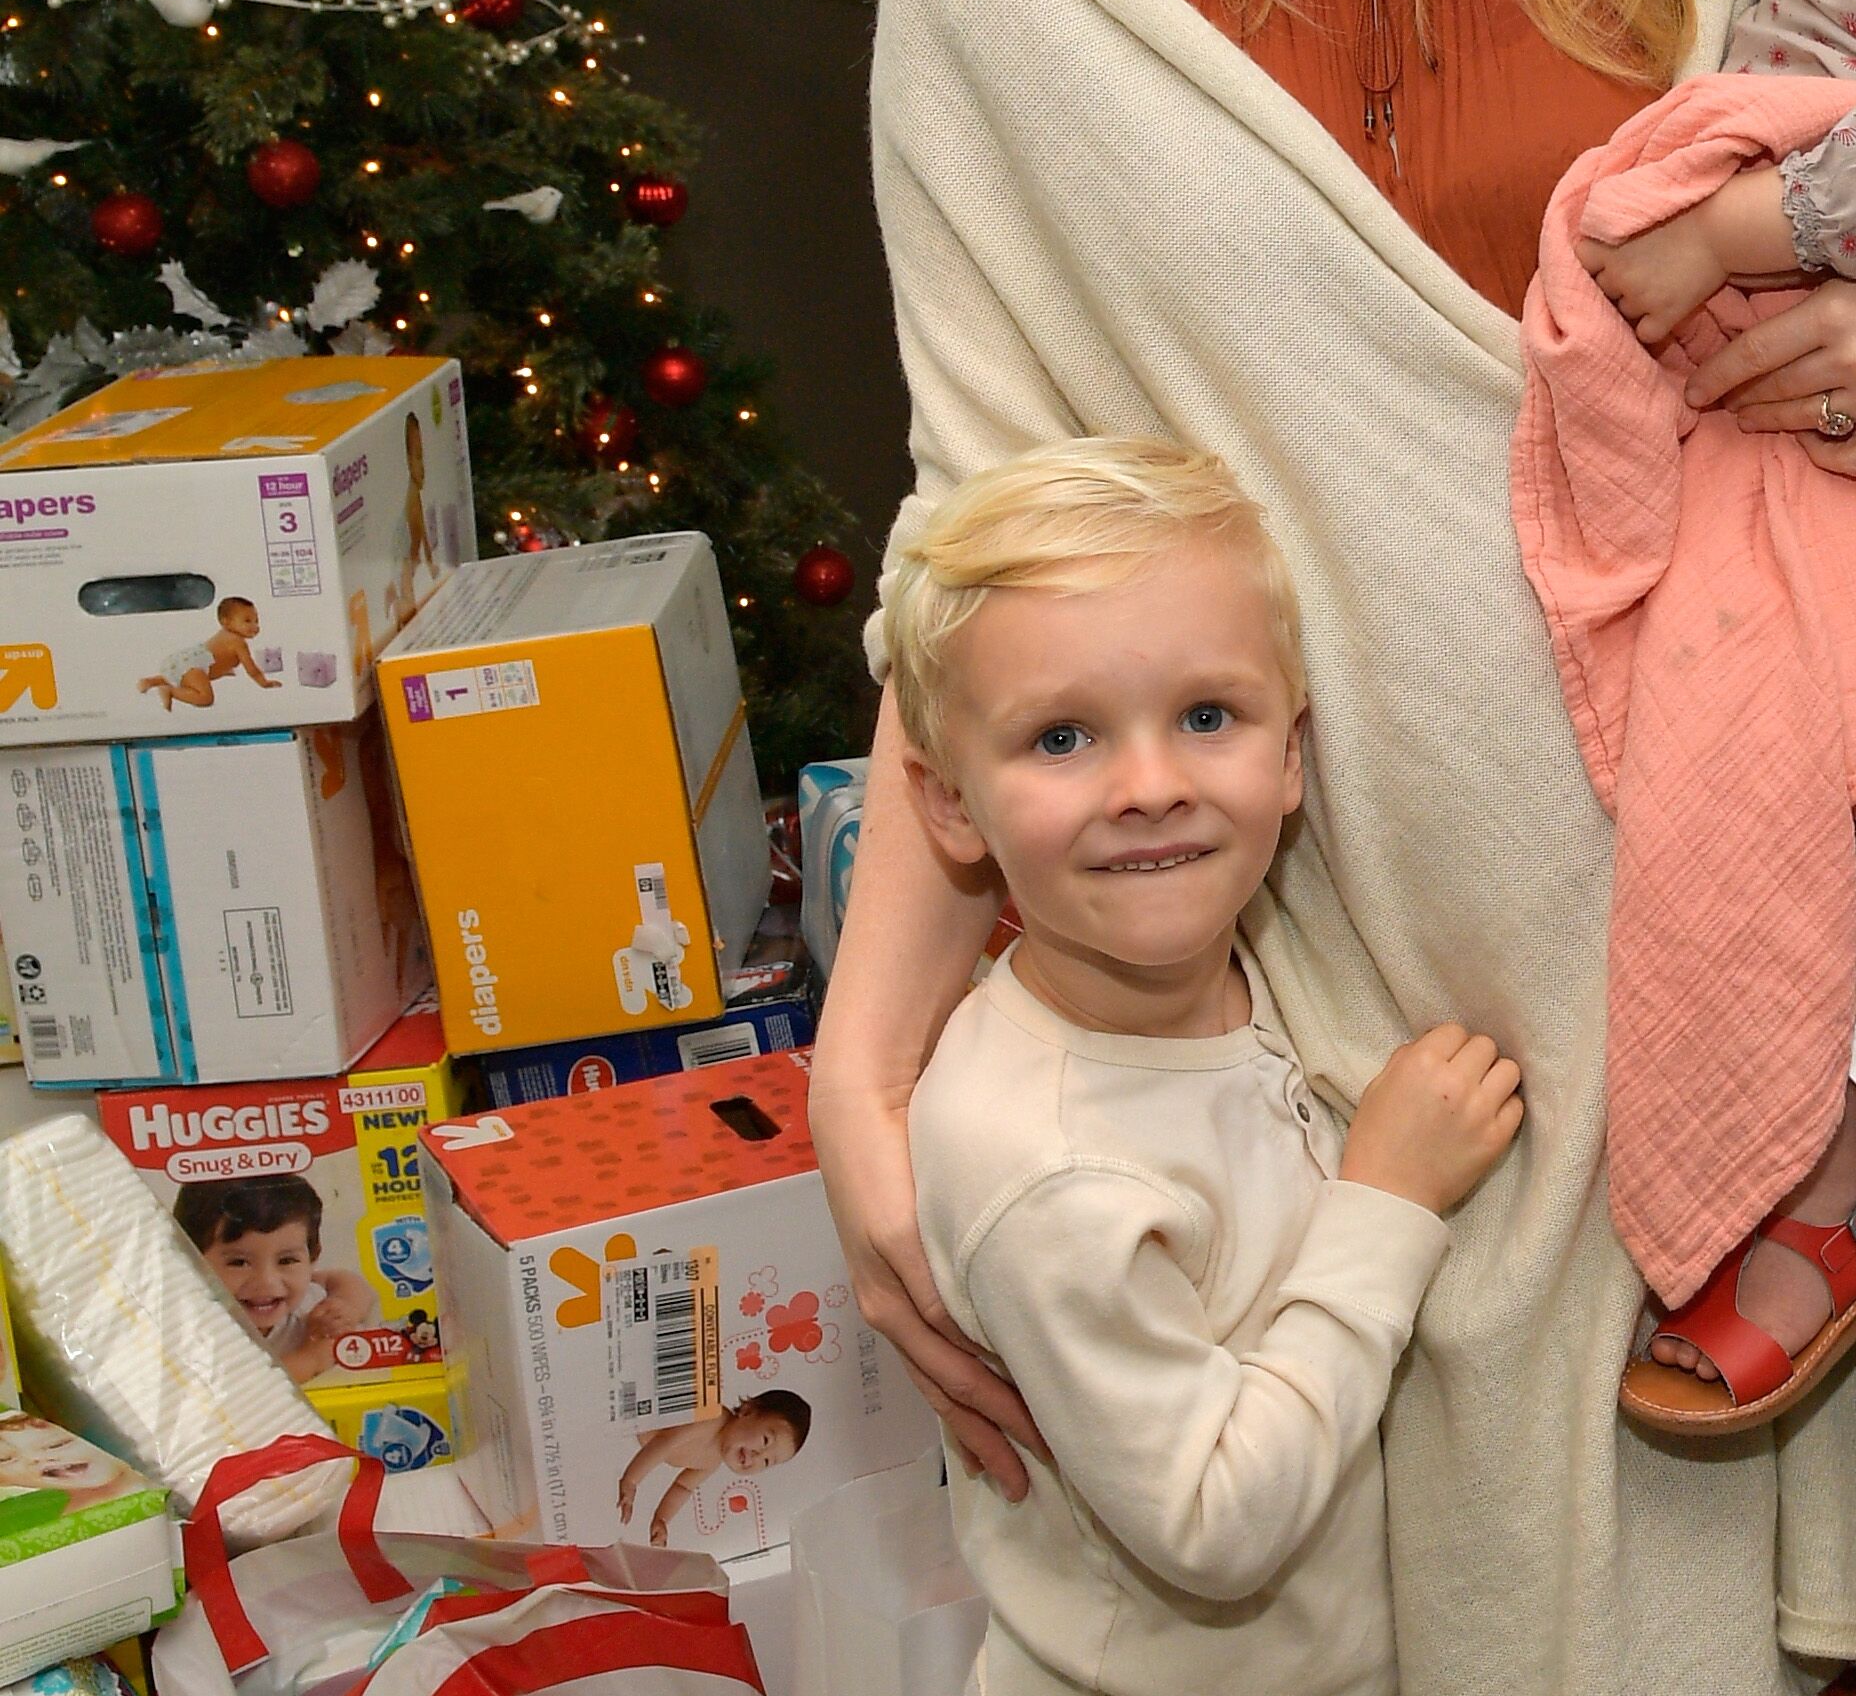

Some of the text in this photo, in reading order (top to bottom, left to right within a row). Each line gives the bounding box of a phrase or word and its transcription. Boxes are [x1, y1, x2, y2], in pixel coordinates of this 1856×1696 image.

[279, 511, 299, 533] 3
[445, 687, 468, 701] 1
[457, 908, 502, 1036] diapers
[343, 1090, 393, 1108] 43111
[399, 1089, 420, 1103] 00
[363, 1110, 428, 1132] NEW!
[177, 1149, 299, 1176] Snug & Dry
[378, 1144, 420, 1179] 12
[518, 1255, 534, 1266] 5
[519, 1267, 542, 1314] PACKS
[526, 1314, 546, 1341] 500
[345, 1336, 360, 1354] 4
[371, 1336, 404, 1355] 112
[704, 1303, 716, 1387] CONVEYABLE FLOW
[529, 1342, 551, 1383] WIPES
[541, 1418, 555, 1431] in
[547, 1465, 563, 1477] in
[546, 1478, 568, 1510] (17.1
[553, 1513, 567, 1533] cm
